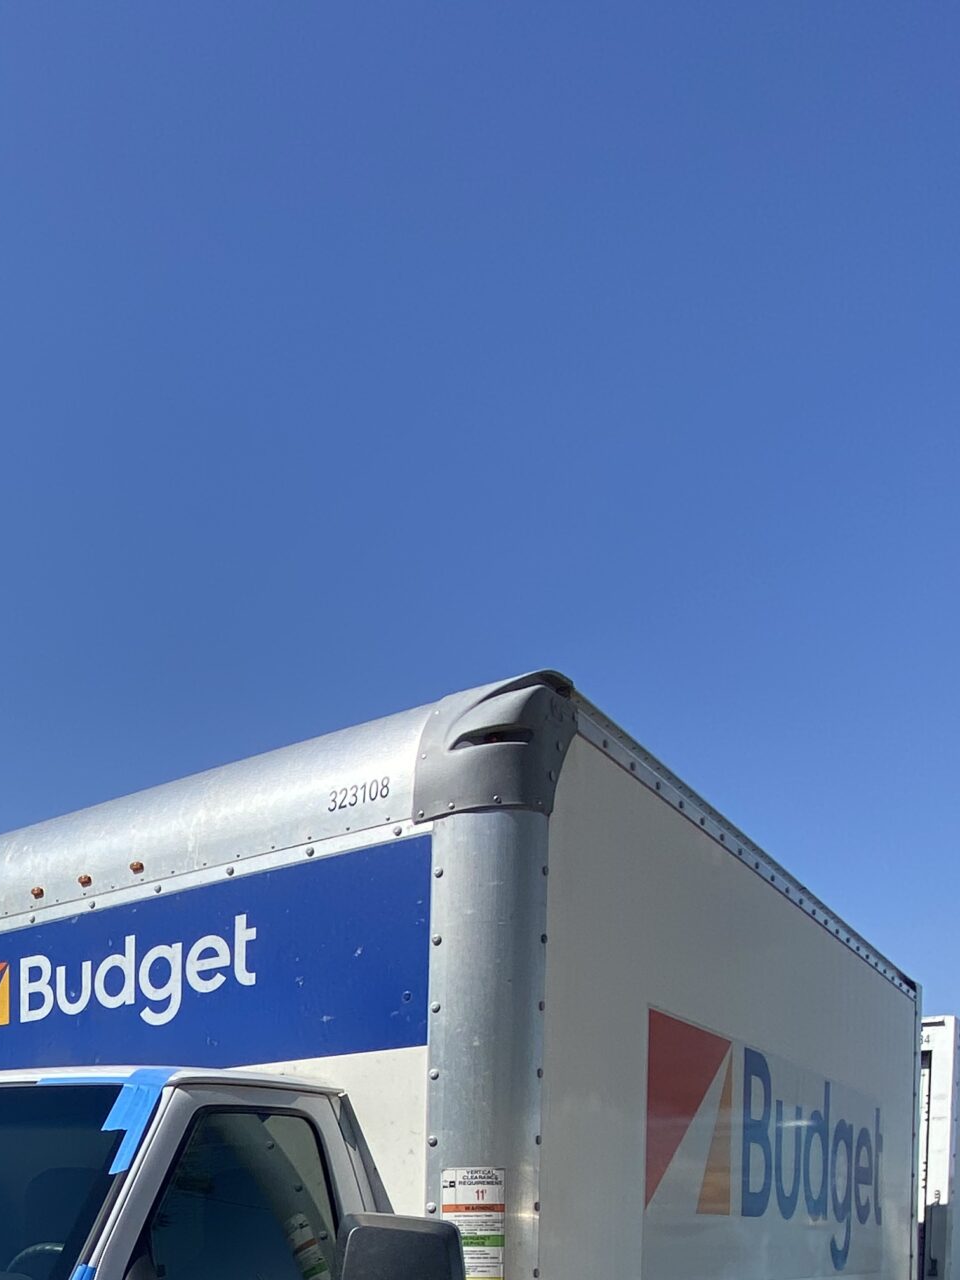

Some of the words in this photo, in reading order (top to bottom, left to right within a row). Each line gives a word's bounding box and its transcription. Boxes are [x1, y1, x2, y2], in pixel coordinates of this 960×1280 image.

[327, 776, 390, 812] 323108
[19, 913, 257, 1026] Budget
[741, 1046, 883, 1271] Budget
